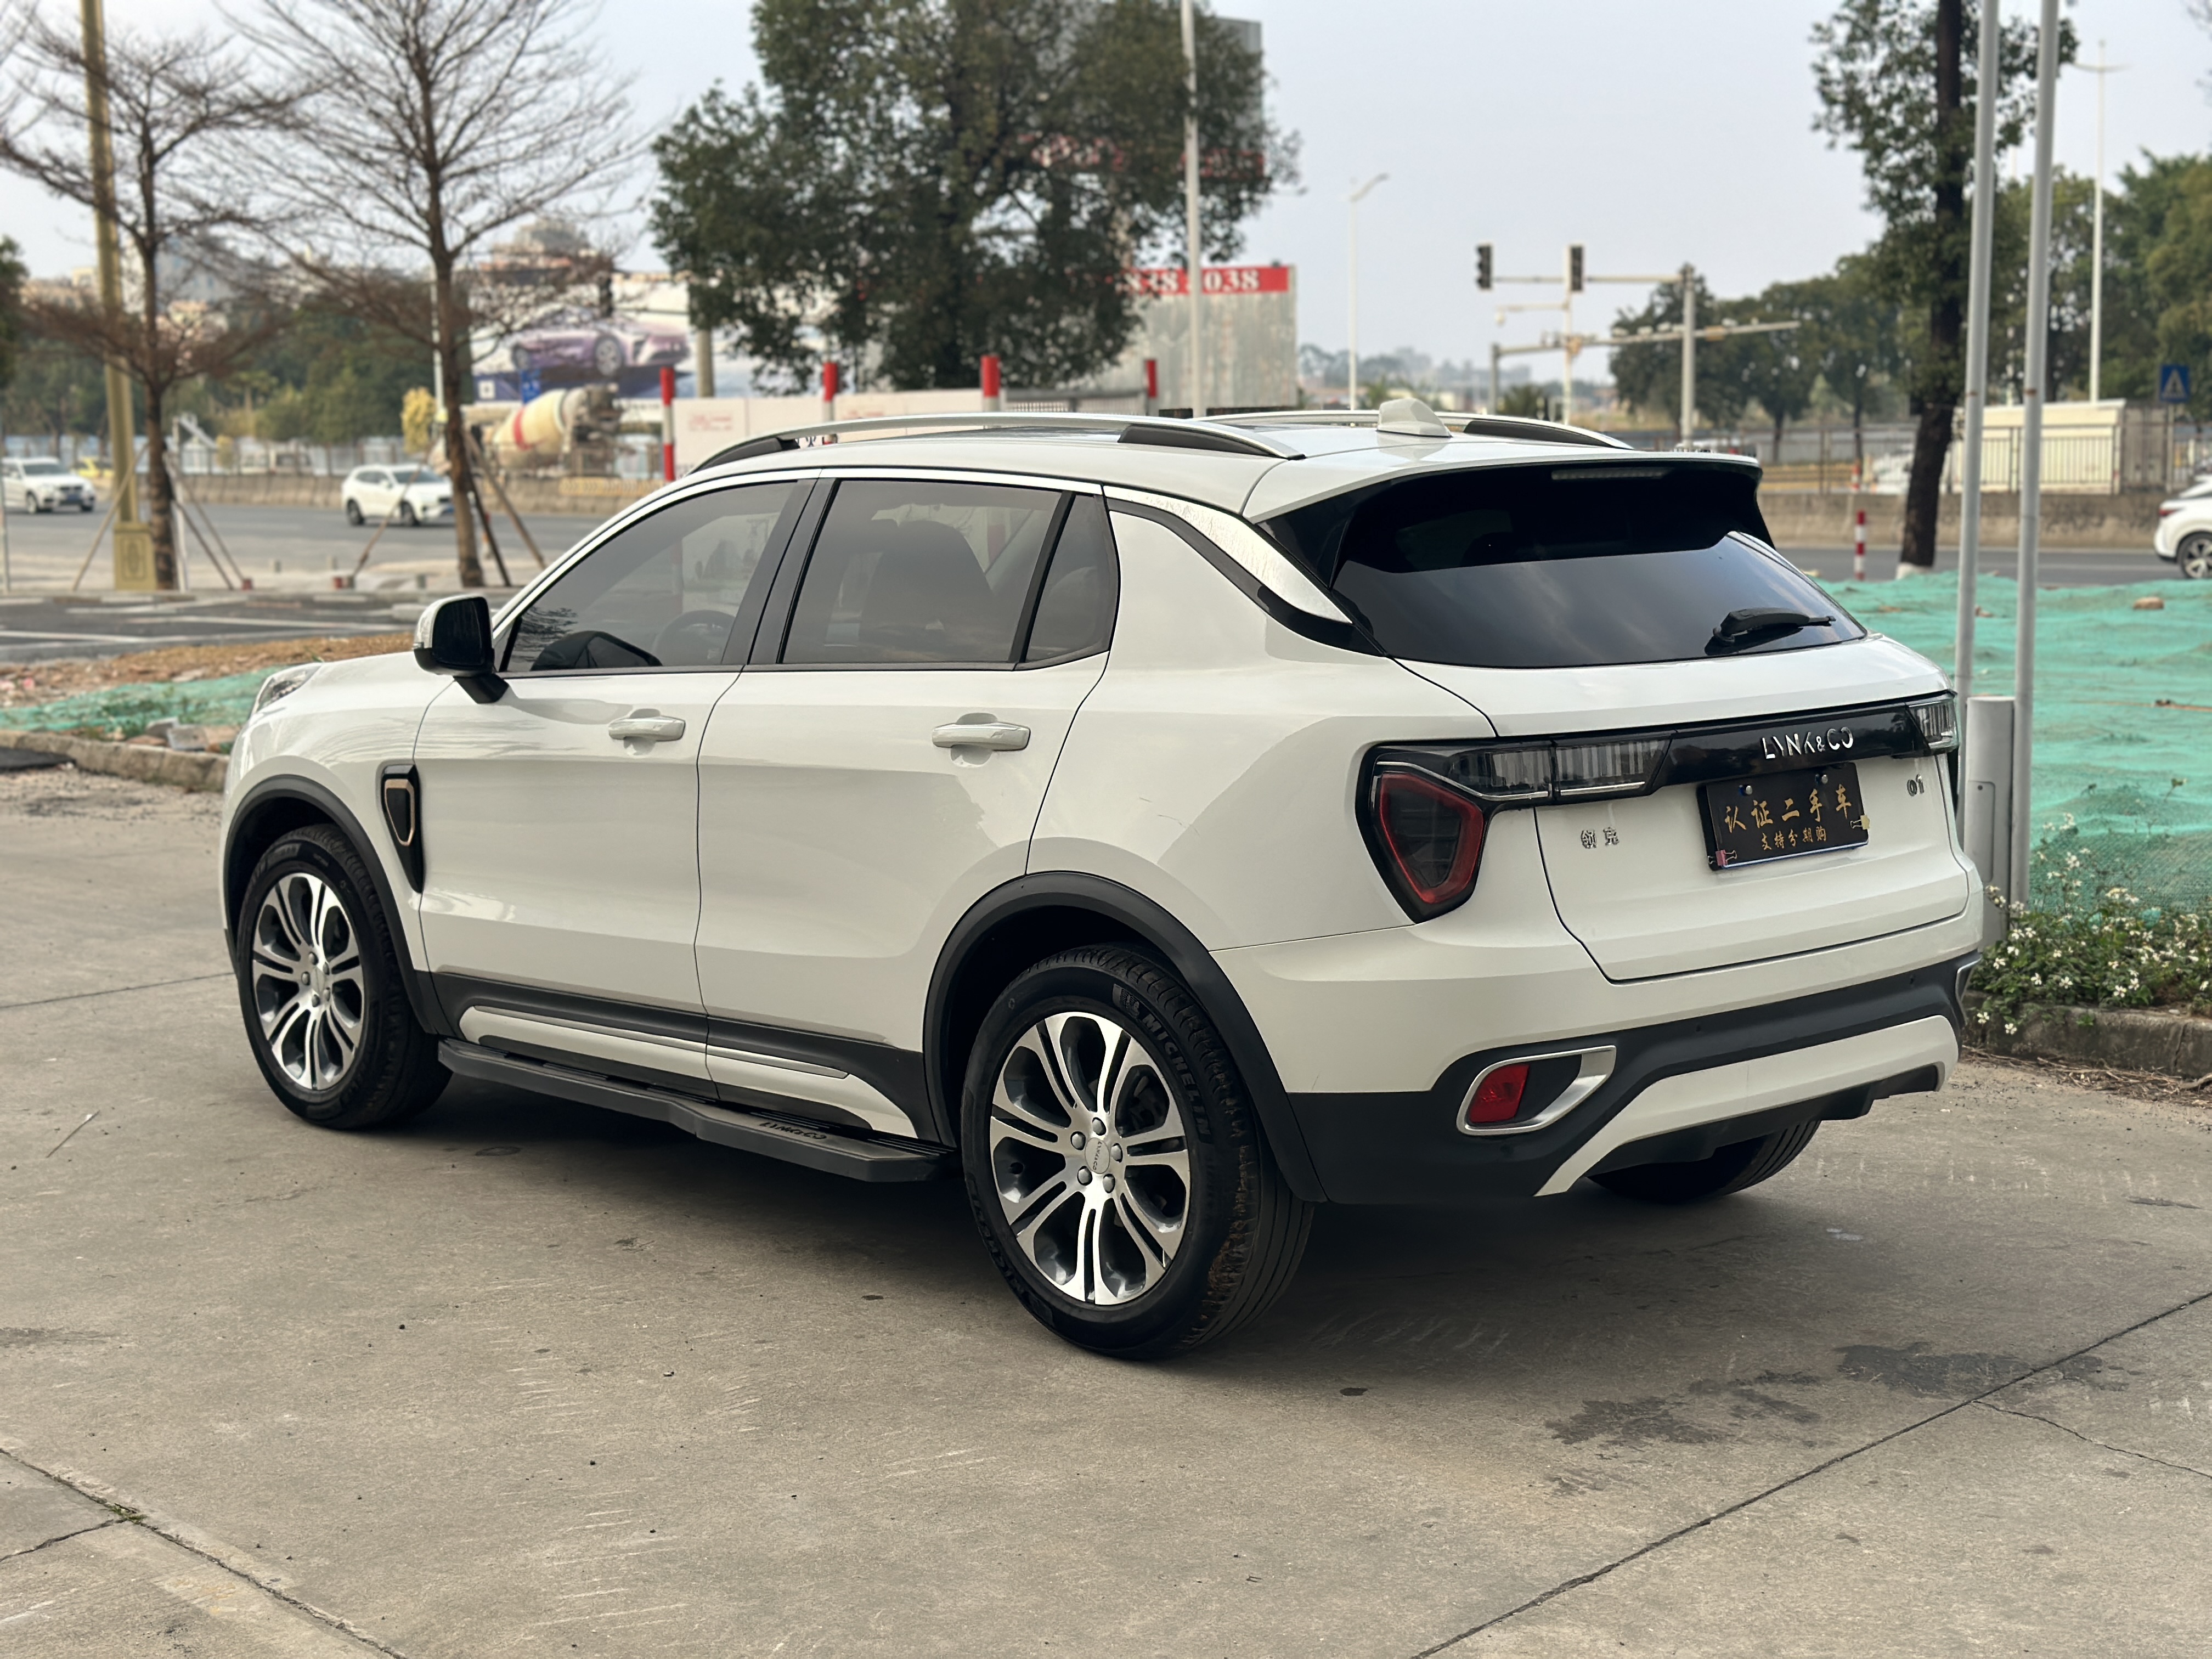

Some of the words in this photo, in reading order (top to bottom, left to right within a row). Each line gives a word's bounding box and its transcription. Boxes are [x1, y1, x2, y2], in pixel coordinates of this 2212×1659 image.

[1906, 773, 1925, 797] 01
[1724, 783, 1852, 833] 认证二手车
[1580, 826, 1620, 849] 领克
[1761, 825, 1827, 850] 支持分期购
[1142, 1013, 1212, 1136] MICHELIN
